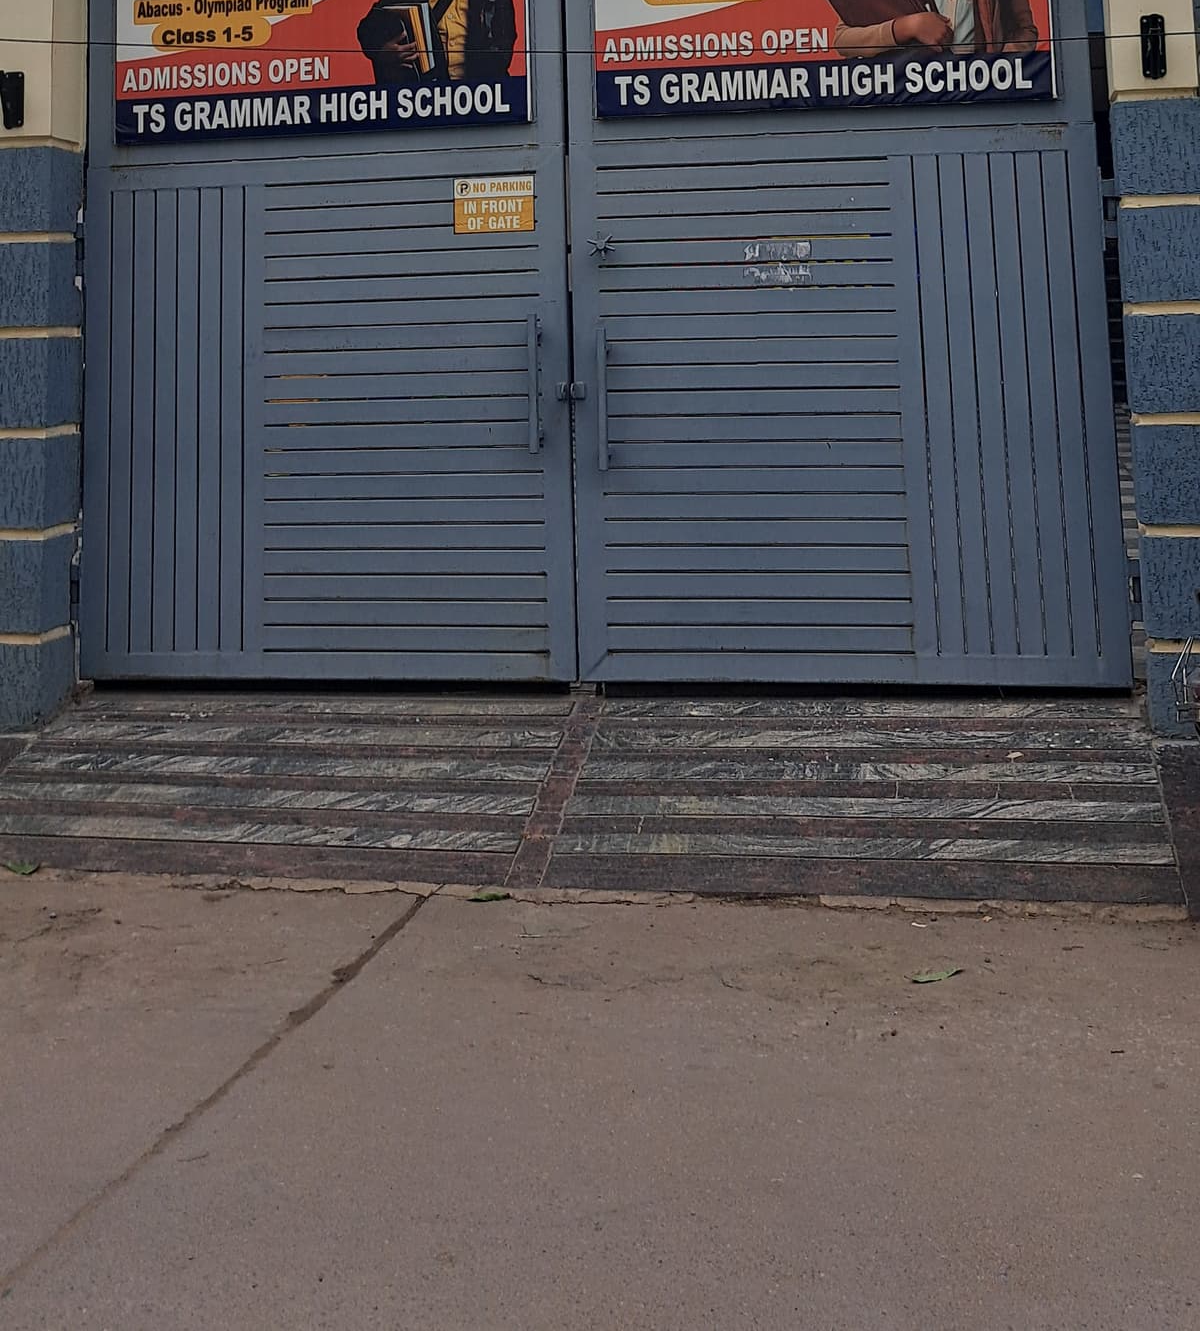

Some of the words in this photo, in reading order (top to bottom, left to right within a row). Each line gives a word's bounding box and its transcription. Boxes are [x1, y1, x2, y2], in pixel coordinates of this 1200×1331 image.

[137, 3, 184, 20] Abacus
[161, 28, 217, 46] Class
[223, 25, 254, 42] 1-5
[602, 31, 754, 63] ADMISSIONS
[762, 28, 829, 55] OPEN
[122, 62, 260, 93] ADMISSIONS
[268, 57, 330, 82] OPEN
[615, 75, 651, 107] TS
[660, 68, 811, 103] GRAMMAR
[819, 63, 895, 97] HIGH
[905, 57, 1033, 93] SCHOOL
[133, 104, 166, 134] TS
[173, 95, 312, 131] GRAMMAR
[320, 90, 388, 124] HIGH
[397, 82, 510, 118] SCHOOL
[472, 183, 486, 193] NO
[489, 181, 532, 192] PARKING
[463, 201, 477, 215] IN
[481, 198, 524, 214] FRONT
[467, 217, 484, 230] OF
[488, 215, 520, 230] GATE
